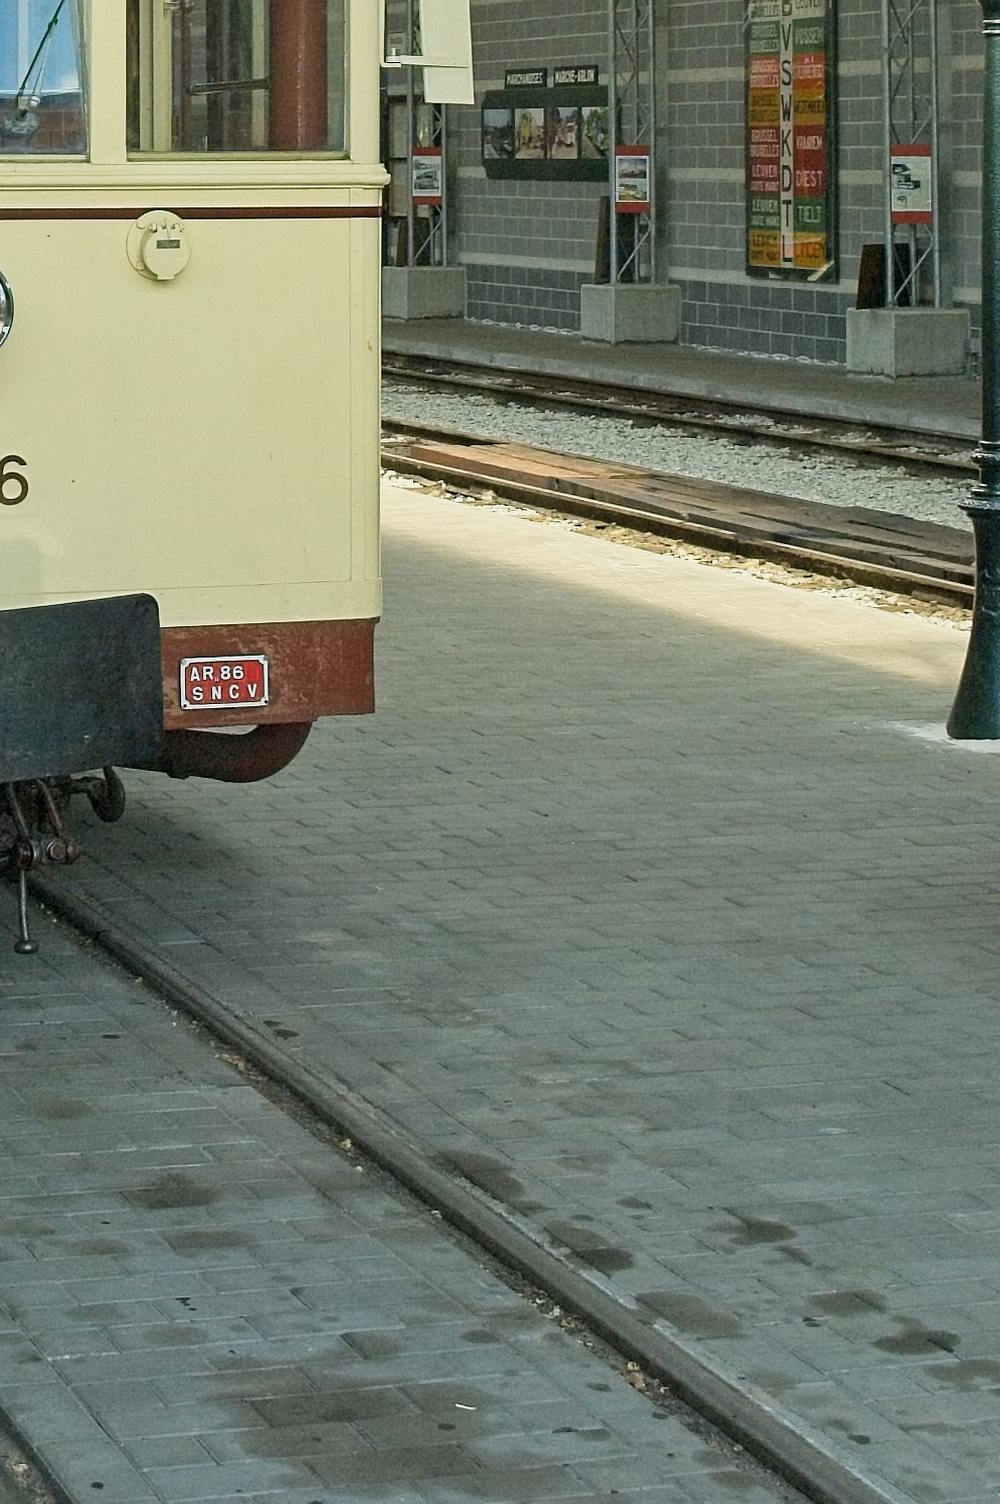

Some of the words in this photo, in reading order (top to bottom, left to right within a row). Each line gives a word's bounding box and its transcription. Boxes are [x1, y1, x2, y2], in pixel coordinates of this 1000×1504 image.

[781, 23, 792, 52] V
[781, 60, 792, 85] S
[781, 94, 792, 122] W
[781, 129, 792, 157] K
[781, 164, 792, 192] D
[782, 200, 792, 227] T
[782, 234, 793, 262] L
